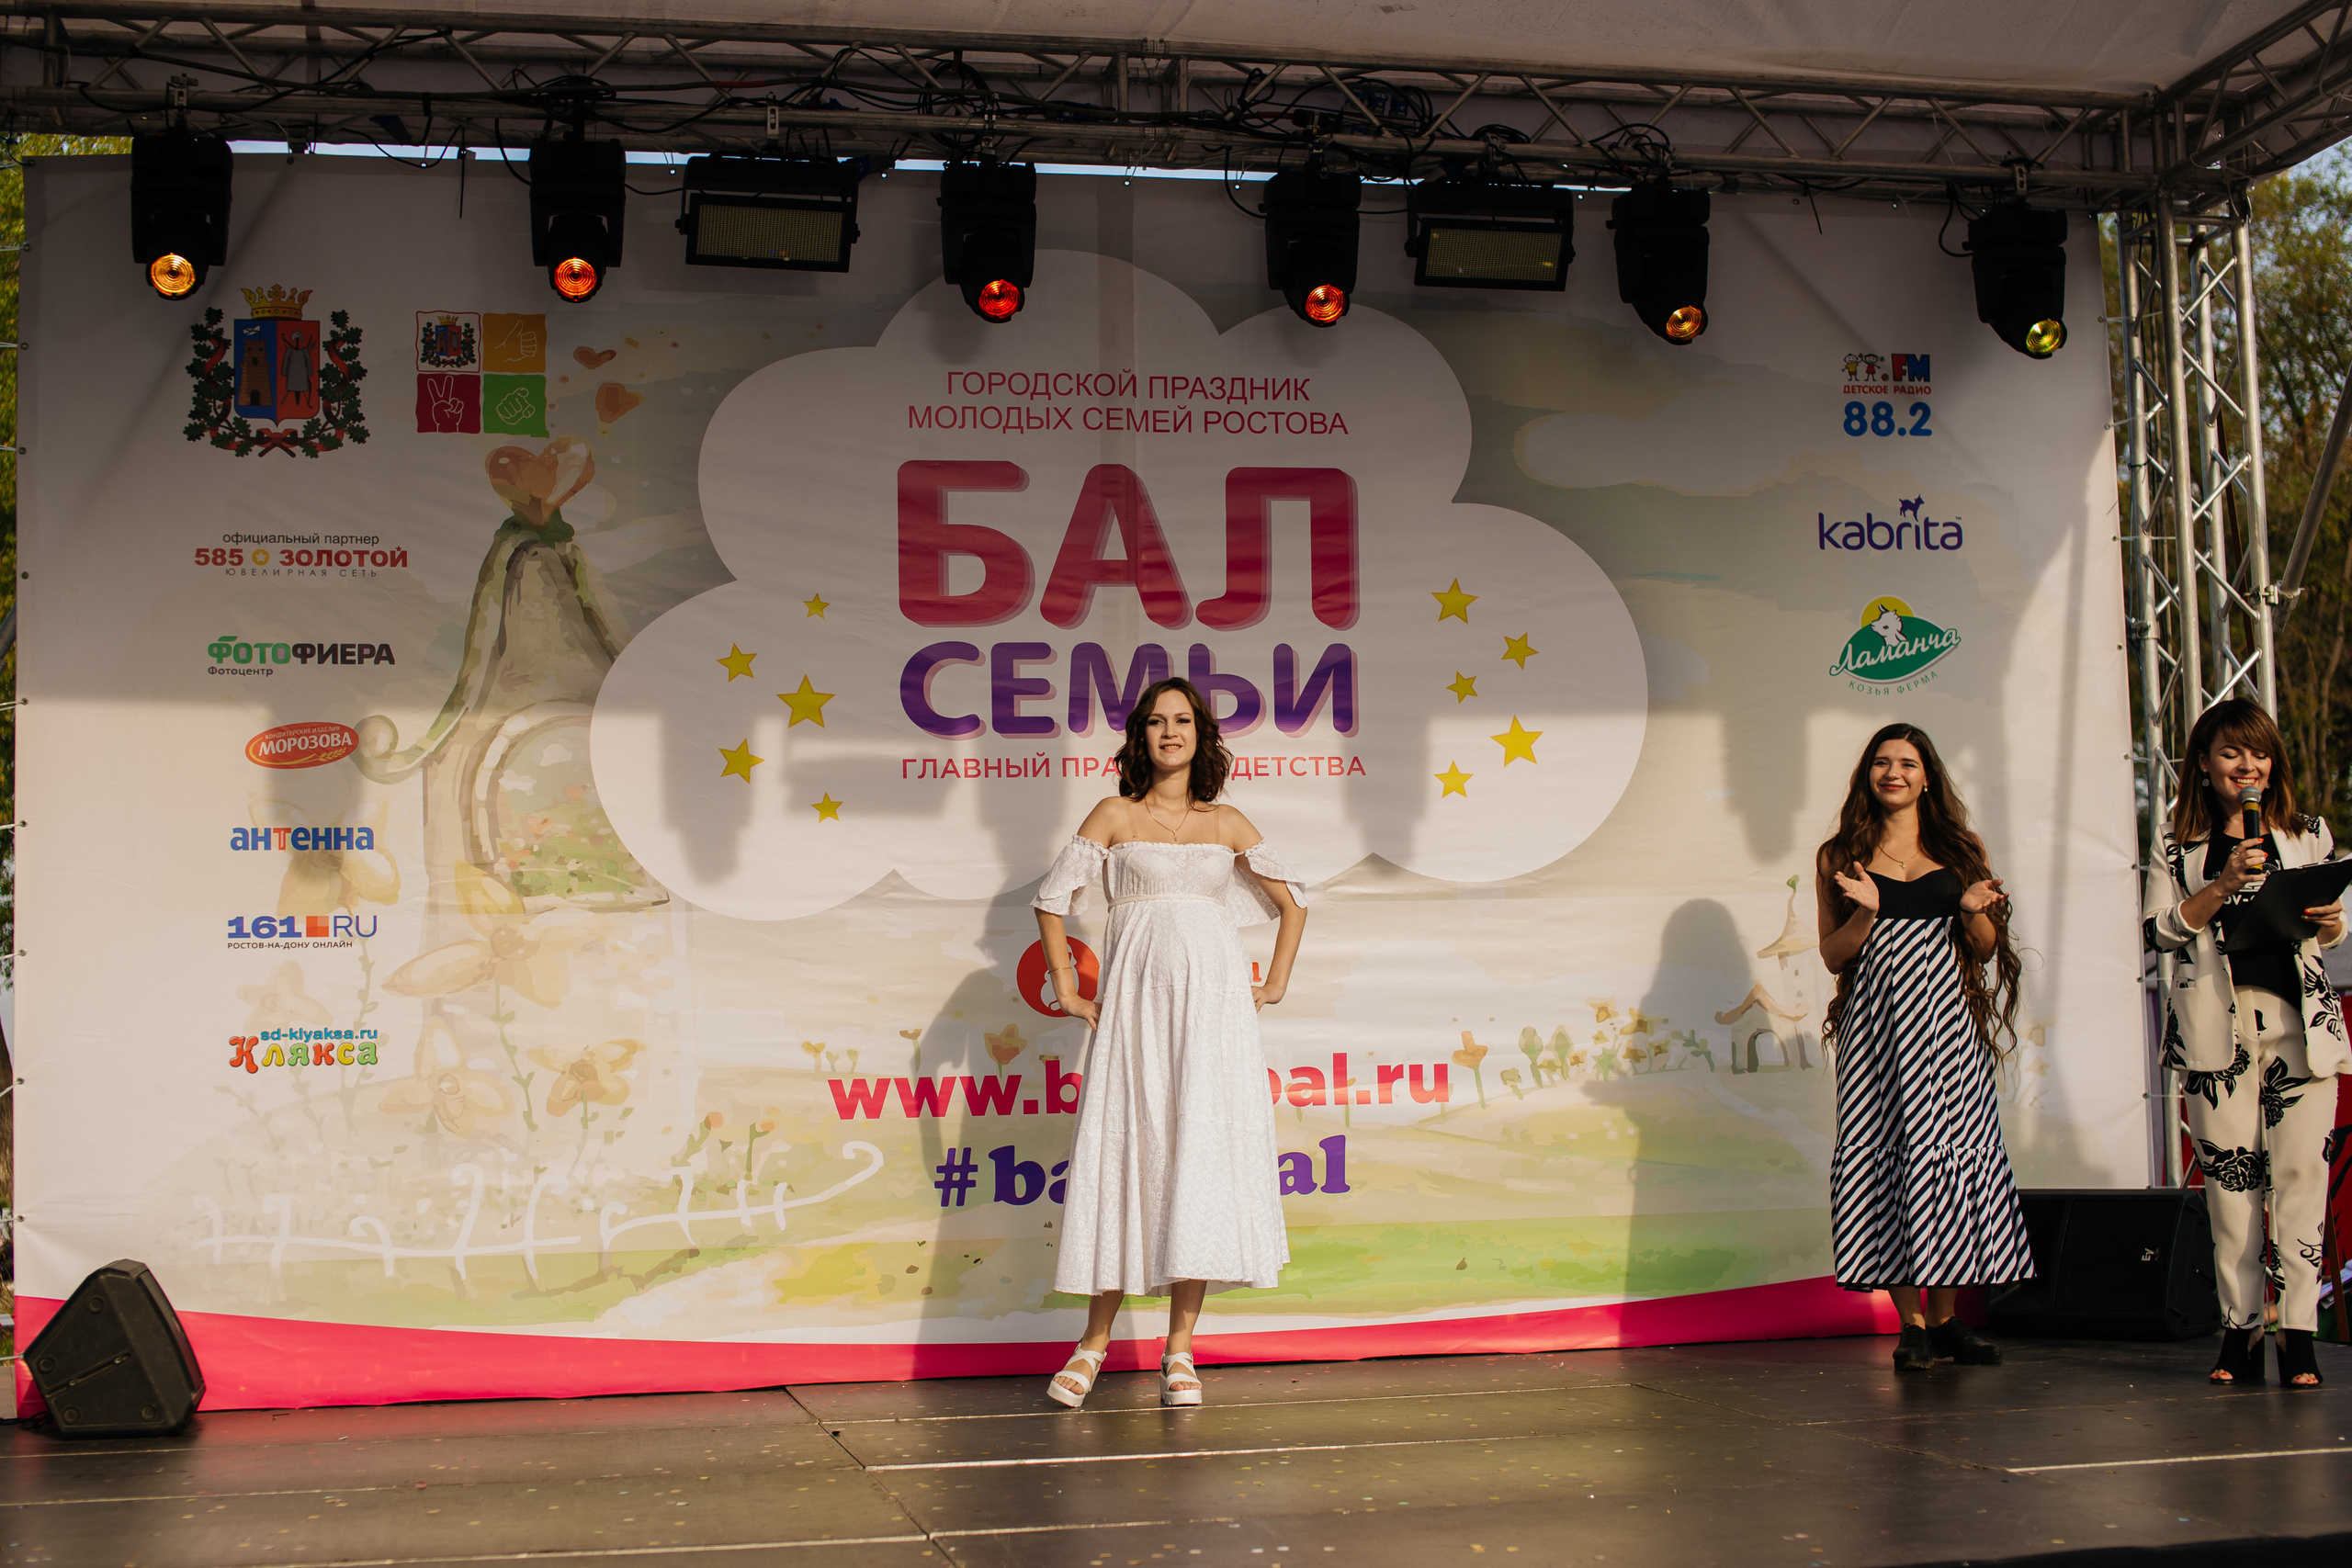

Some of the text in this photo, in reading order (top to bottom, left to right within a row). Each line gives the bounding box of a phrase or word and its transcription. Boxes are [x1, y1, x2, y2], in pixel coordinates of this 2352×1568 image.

[947, 368, 1310, 405] ГОРОДСКОЙ ПРАЗДНИК
[1842, 384, 1932, 396] ДЕТСКОЕ РАДИО
[908, 405, 1350, 435] МОЛОДЫХ СЕМЕЙ РОСТОВА
[1843, 400, 1933, 437] 88.2
[222, 532, 380, 547] официальный партнер
[1818, 513, 1963, 550] kabrita
[194, 546, 409, 568] 585 ЗОЛОТОЙ
[897, 459, 1360, 631] БАЛ
[225, 568, 378, 578] ЮВЕЛИРНАЯ СЕТЬ
[207, 636, 396, 665] ФОТОФИЕРА
[1829, 627, 1962, 677] Ламанча
[208, 666, 274, 677] Фотоцентр
[1849, 671, 1939, 696] КОЗЬЯ ФЕРМА
[899, 640, 1360, 741] СЕМЬИ
[258, 731, 353, 757] МОРОЗОВА
[265, 726, 341, 740] КОНДИТЕРСКИЕ ИЗДЕЛИЯ
[902, 751, 1050, 779] ГЛАВНЫЙ
[1231, 756, 1367, 781] ДЕТСТВА
[230, 826, 375, 852] антенна
[228, 915, 378, 939] 161 RU
[227, 940, 354, 950] РОСТОВ-НА-ДОНУ ОНЛАЙН
[260, 1027, 379, 1043] sd-klyaksa.ru
[229, 1036, 379, 1075] Клякса
